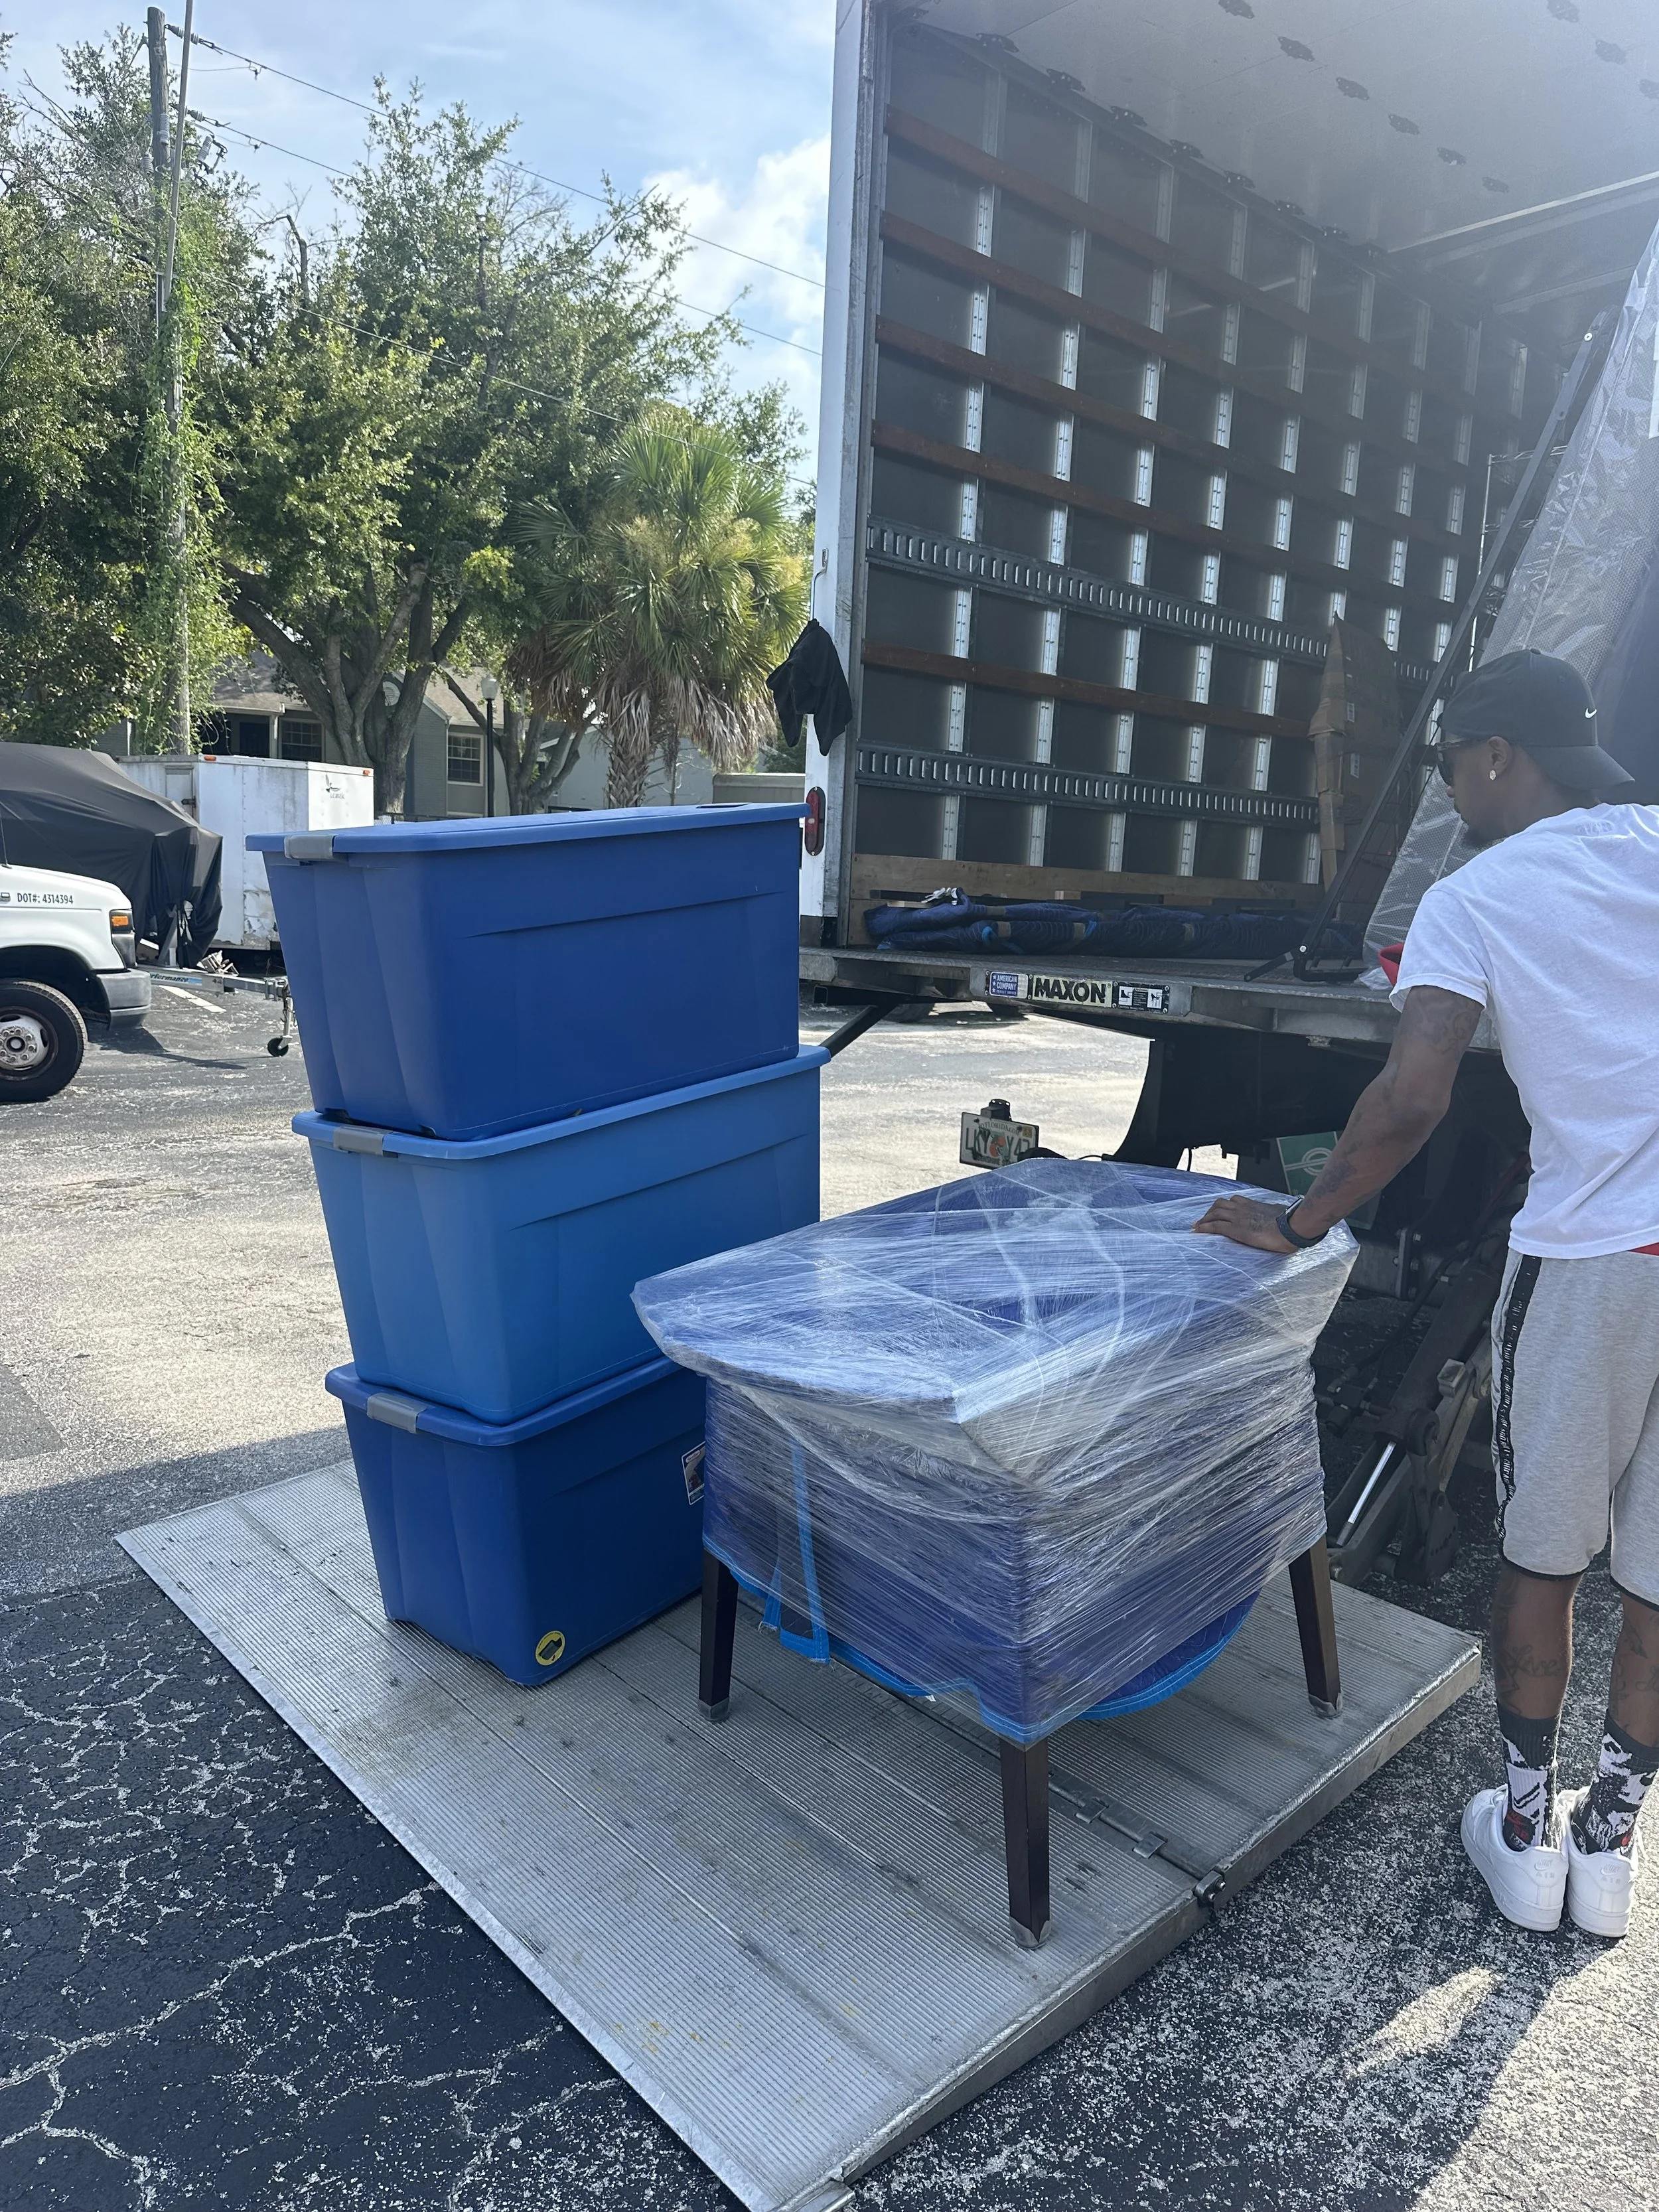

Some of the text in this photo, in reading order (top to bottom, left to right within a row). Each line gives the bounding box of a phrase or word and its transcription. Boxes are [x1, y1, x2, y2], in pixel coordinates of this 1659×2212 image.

[42, 894, 73, 904] 4314394
[996, 982, 1017, 991] COMPANY
[1035, 978, 1106, 1003] MAXON
